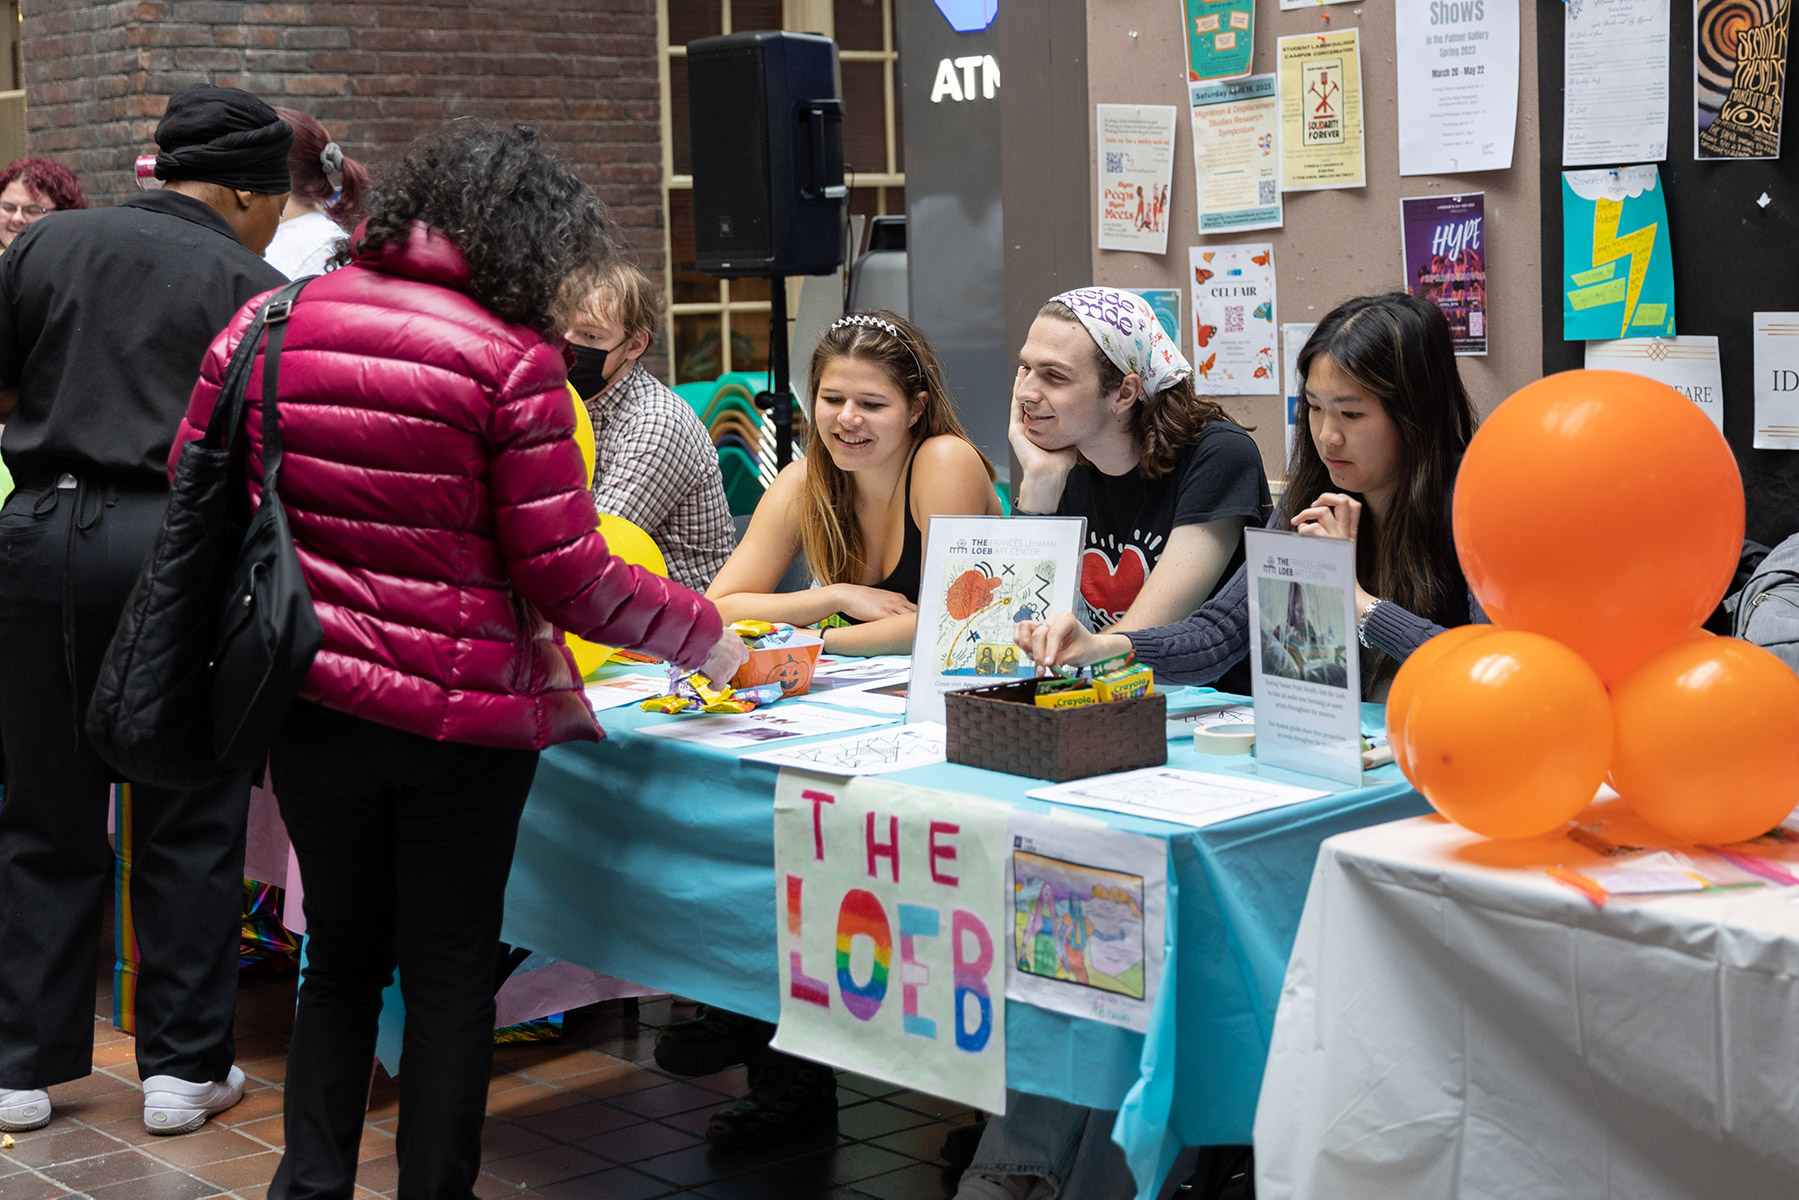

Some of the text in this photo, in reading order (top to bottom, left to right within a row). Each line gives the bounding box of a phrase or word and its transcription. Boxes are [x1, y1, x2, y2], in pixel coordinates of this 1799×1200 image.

[1430, 1, 1485, 25] Shows
[1426, 31, 1489, 45] in the Palmer Gallery
[1439, 45, 1476, 58] Spring 2023
[1432, 68, 1450, 78] March
[1451, 67, 1459, 76] 20
[1463, 66, 1476, 76] May
[1477, 65, 1485, 74] 22
[1196, 90, 1227, 99] Saturday
[1194, 108, 1225, 119] Migration
[1233, 101, 1275, 114] Displacement
[1208, 113, 1264, 127] Studies Research
[1308, 120, 1339, 130] SOLIDARITY
[1218, 126, 1255, 138] Symposium
[1309, 130, 1340, 140] FOREVER
[1104, 188, 1134, 203] Peeps
[1105, 208, 1134, 220] Meets
[1432, 217, 1482, 261] HYPE
[1211, 286, 1257, 297] CEL FAIR
[990, 539, 1023, 547] FRANCES
[1024, 540, 1056, 548] LEHMAN
[972, 547, 992, 555] LOEB
[1010, 548, 1040, 556] CENTER
[1277, 557, 1289, 566] THE
[1278, 568, 1326, 580] LOEB ART CENTER
[1093, 666, 1104, 676] 24
[1114, 677, 1147, 694] Crayola
[1057, 696, 1092, 708] Crayola
[801, 789, 961, 888] THE
[787, 873, 995, 1053] LOEB
